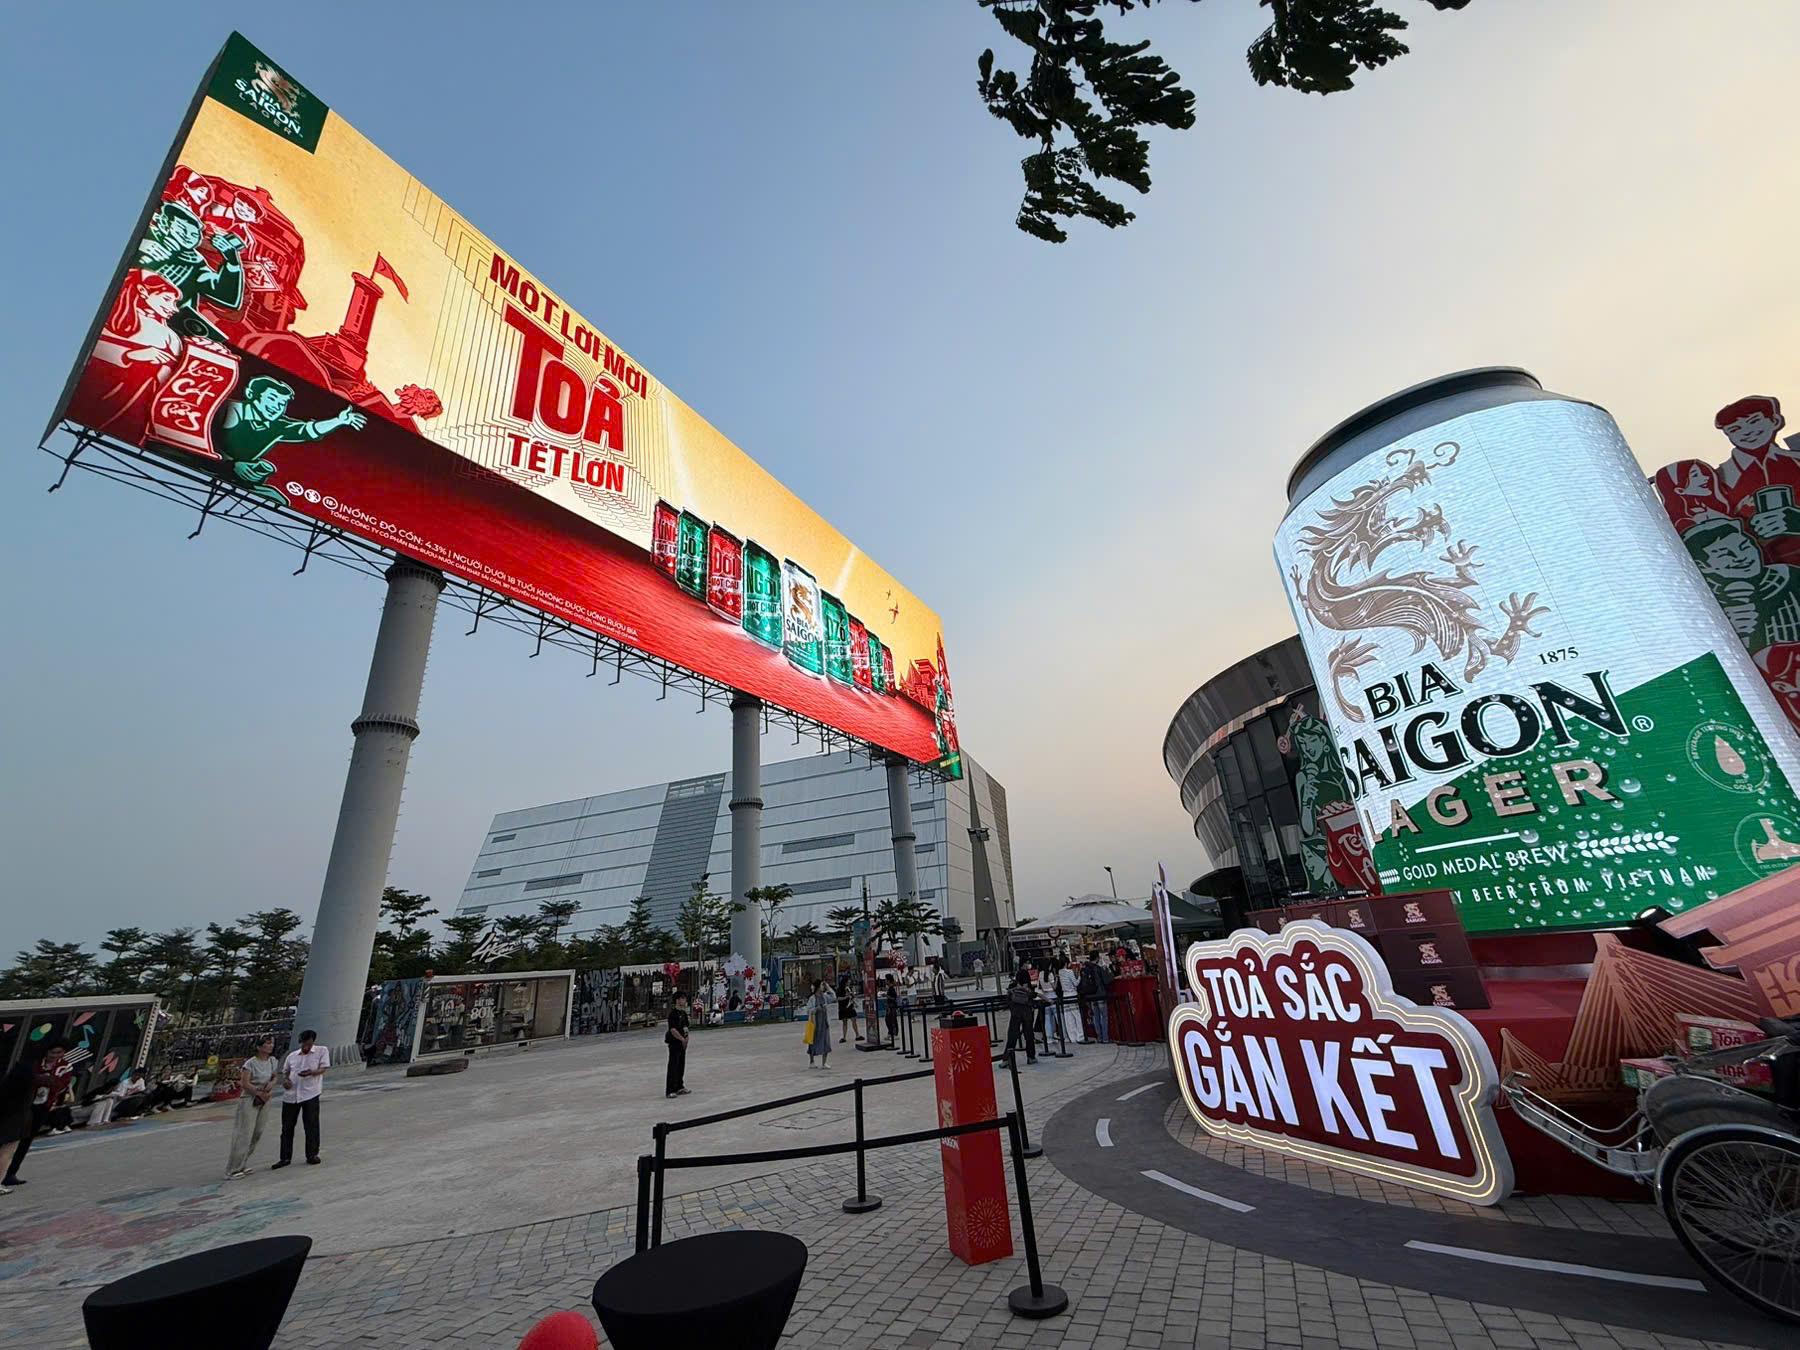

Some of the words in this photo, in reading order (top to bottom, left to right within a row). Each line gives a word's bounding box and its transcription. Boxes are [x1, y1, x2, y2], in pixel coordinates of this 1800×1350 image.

[234, 79, 301, 134] SAIGON
[489, 252, 559, 325] MỘT
[570, 452, 625, 493] LỚN
[1538, 646, 1579, 665] 1875
[1363, 661, 1463, 723] BIA
[1364, 759, 1619, 844] LAGER
[1403, 864, 1438, 882] GOLD
[1441, 854, 1503, 876] MEDAL
[1507, 844, 1568, 868] BREW
[1473, 884, 1518, 903] BEER
[1530, 877, 1590, 898] FROM
[1602, 865, 1713, 891] VIETNAM
[1203, 957, 1275, 1019] TOẢ
[1275, 952, 1361, 1023] SẮC
[1184, 1021, 1300, 1127] GẮN
[1299, 1033, 1461, 1160] KẾT
